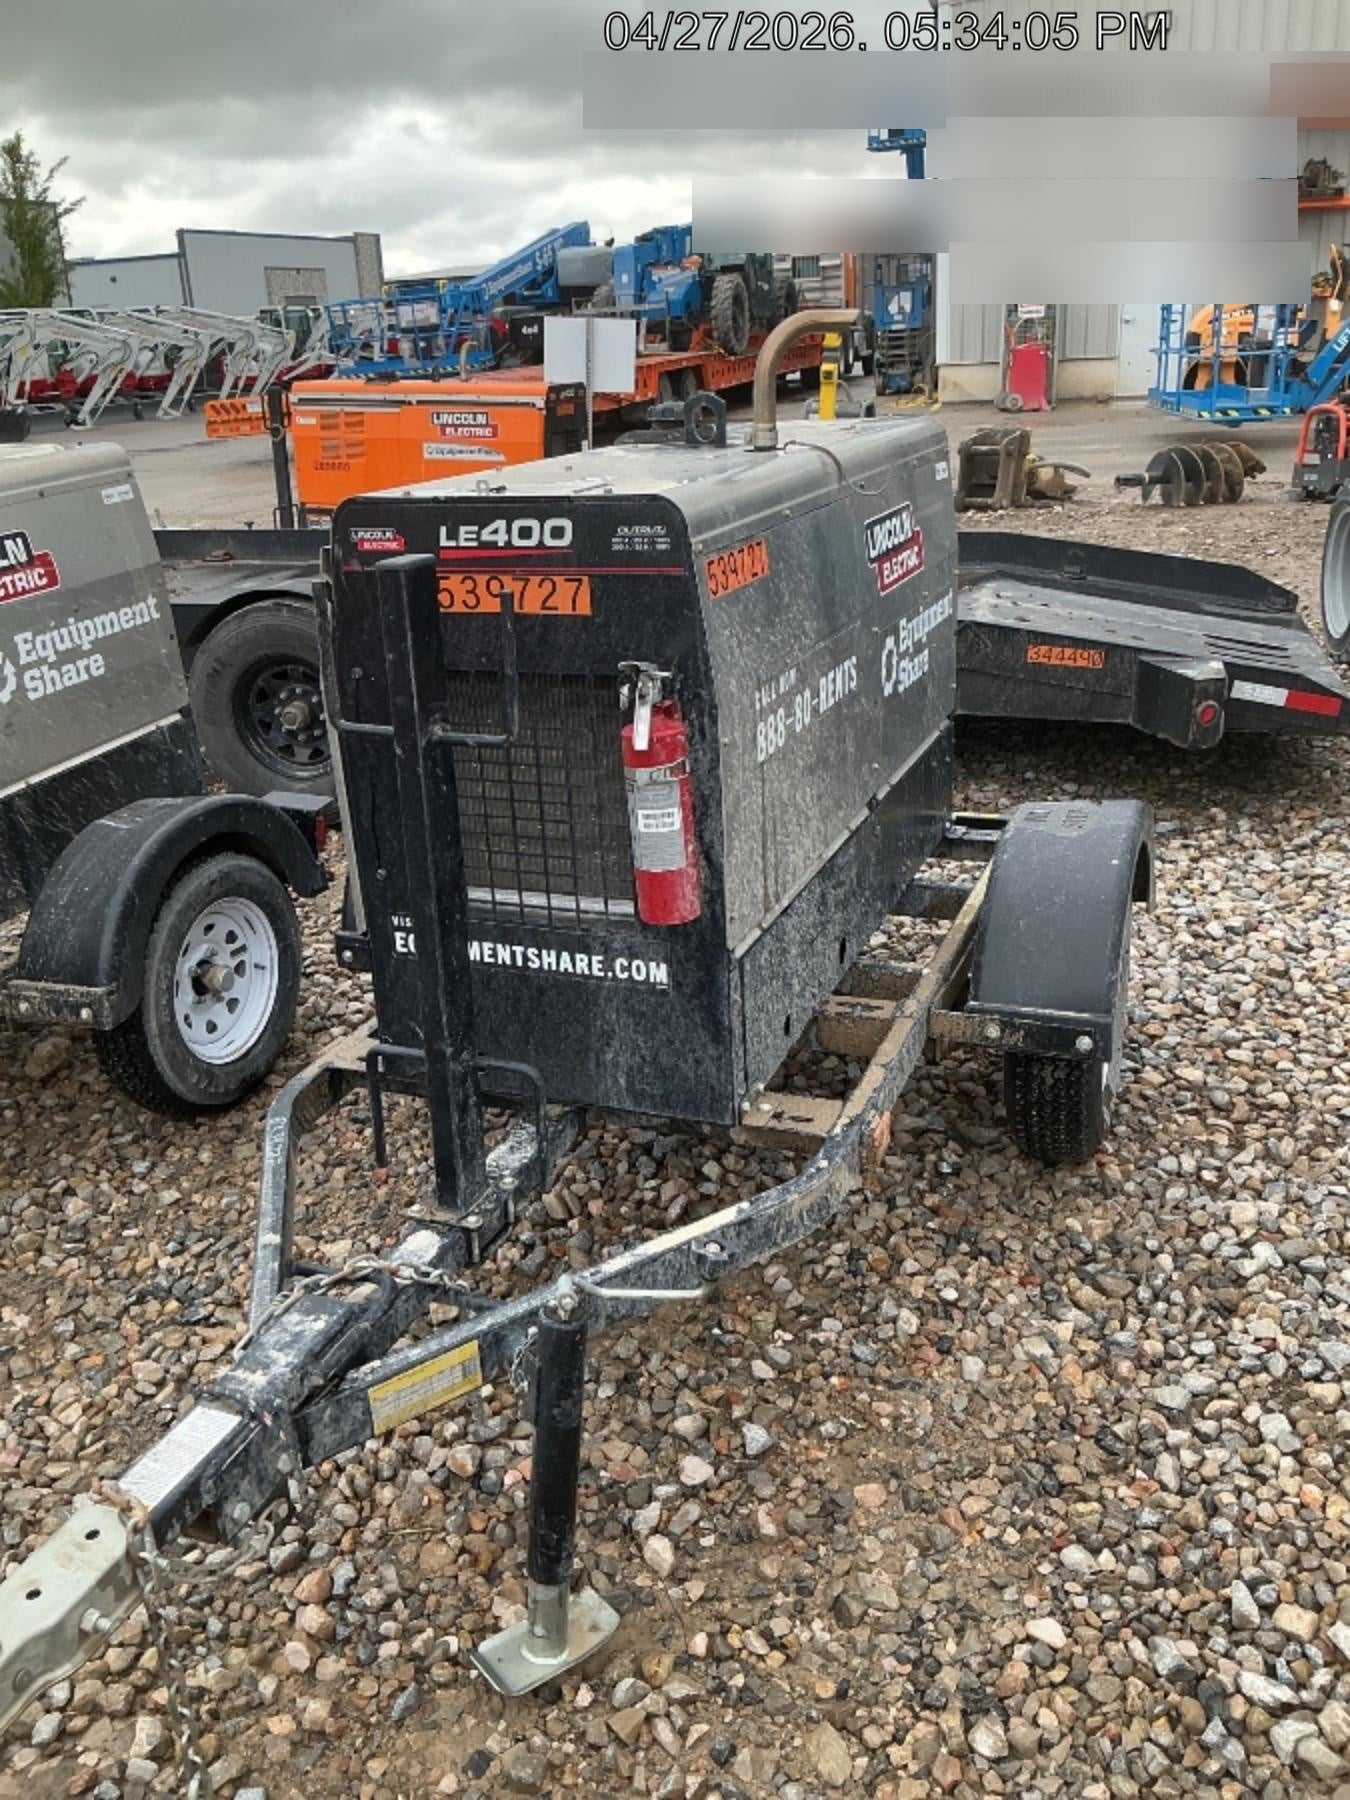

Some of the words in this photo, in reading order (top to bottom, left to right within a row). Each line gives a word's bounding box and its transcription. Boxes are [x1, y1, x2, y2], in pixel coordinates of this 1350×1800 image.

[433, 413, 487, 425] LINCOLN
[445, 427, 493, 437] ELECTRIC
[439, 518, 573, 547] LE400
[867, 511, 913, 559] LINCOLN
[707, 540, 765, 596] 539727
[883, 545, 919, 585] ELECTRIC
[438, 575, 583, 612] 539727
[14, 593, 160, 665] Equipment
[900, 588, 953, 653] Equipment
[23, 653, 105, 700] Share
[897, 648, 928, 694] Share
[1029, 646, 1103, 667] 344490
[757, 655, 857, 762] 888-80-RENTS
